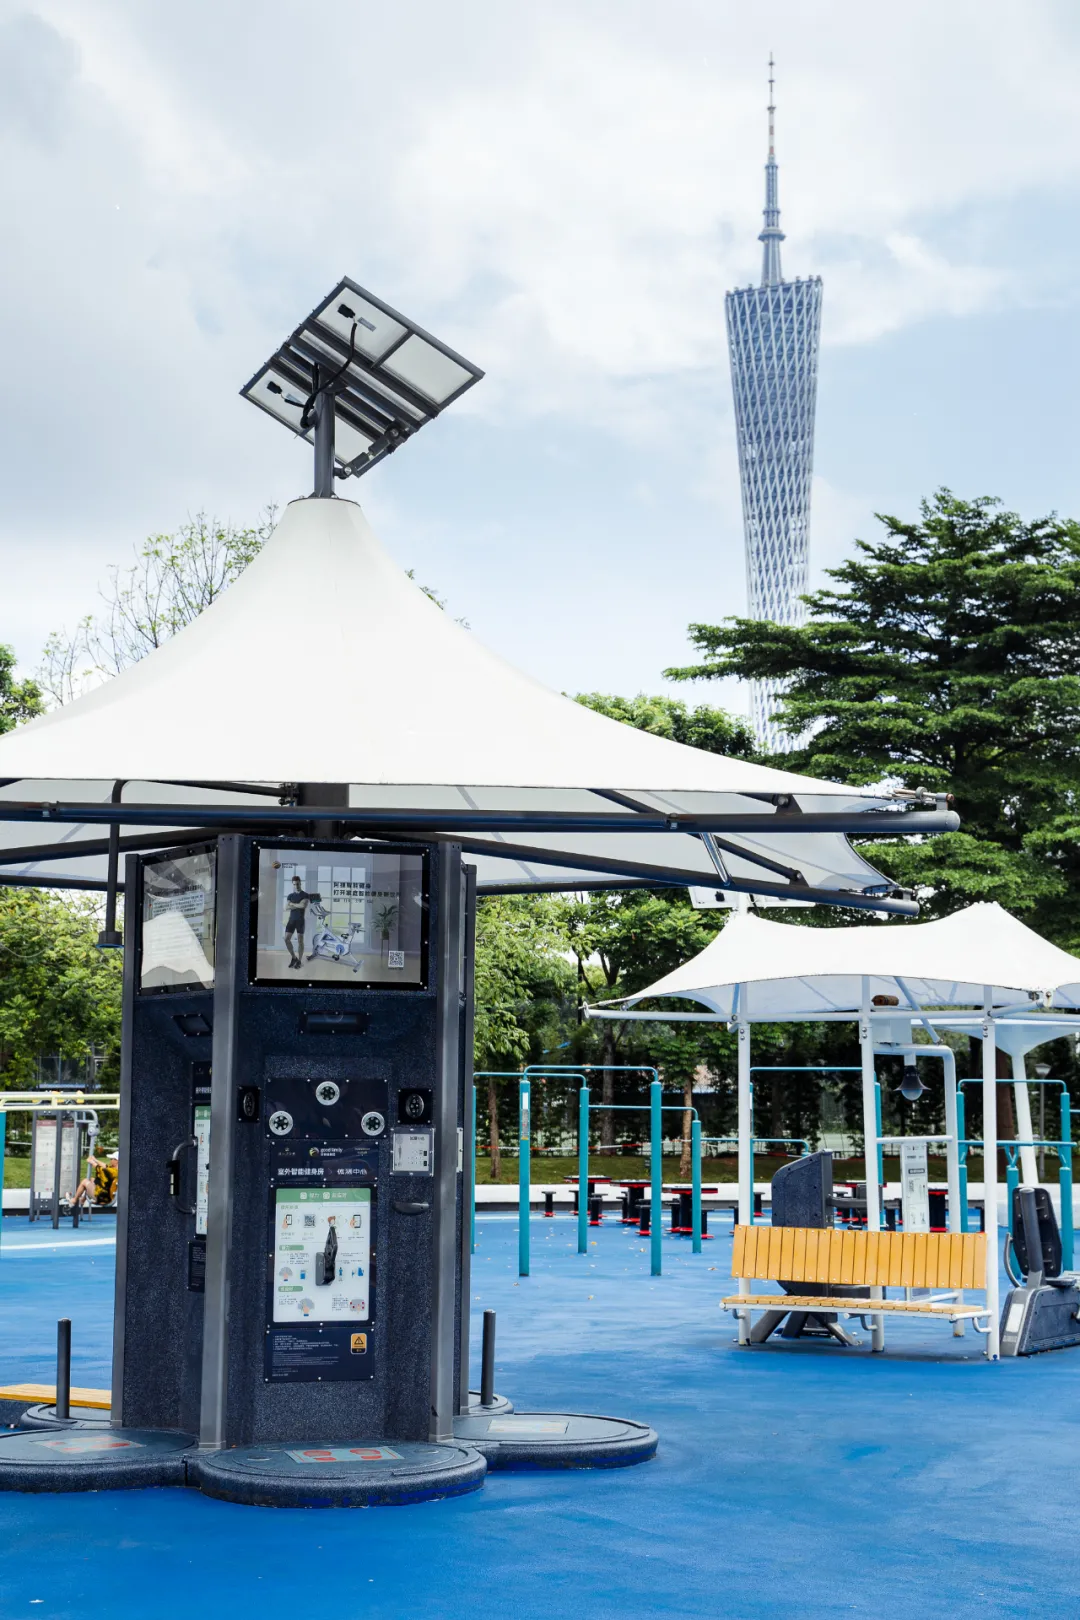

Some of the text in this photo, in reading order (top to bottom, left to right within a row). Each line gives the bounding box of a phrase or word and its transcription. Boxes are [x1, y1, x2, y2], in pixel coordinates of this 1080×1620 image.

[277, 1167, 324, 1176] 室外智能健身房
